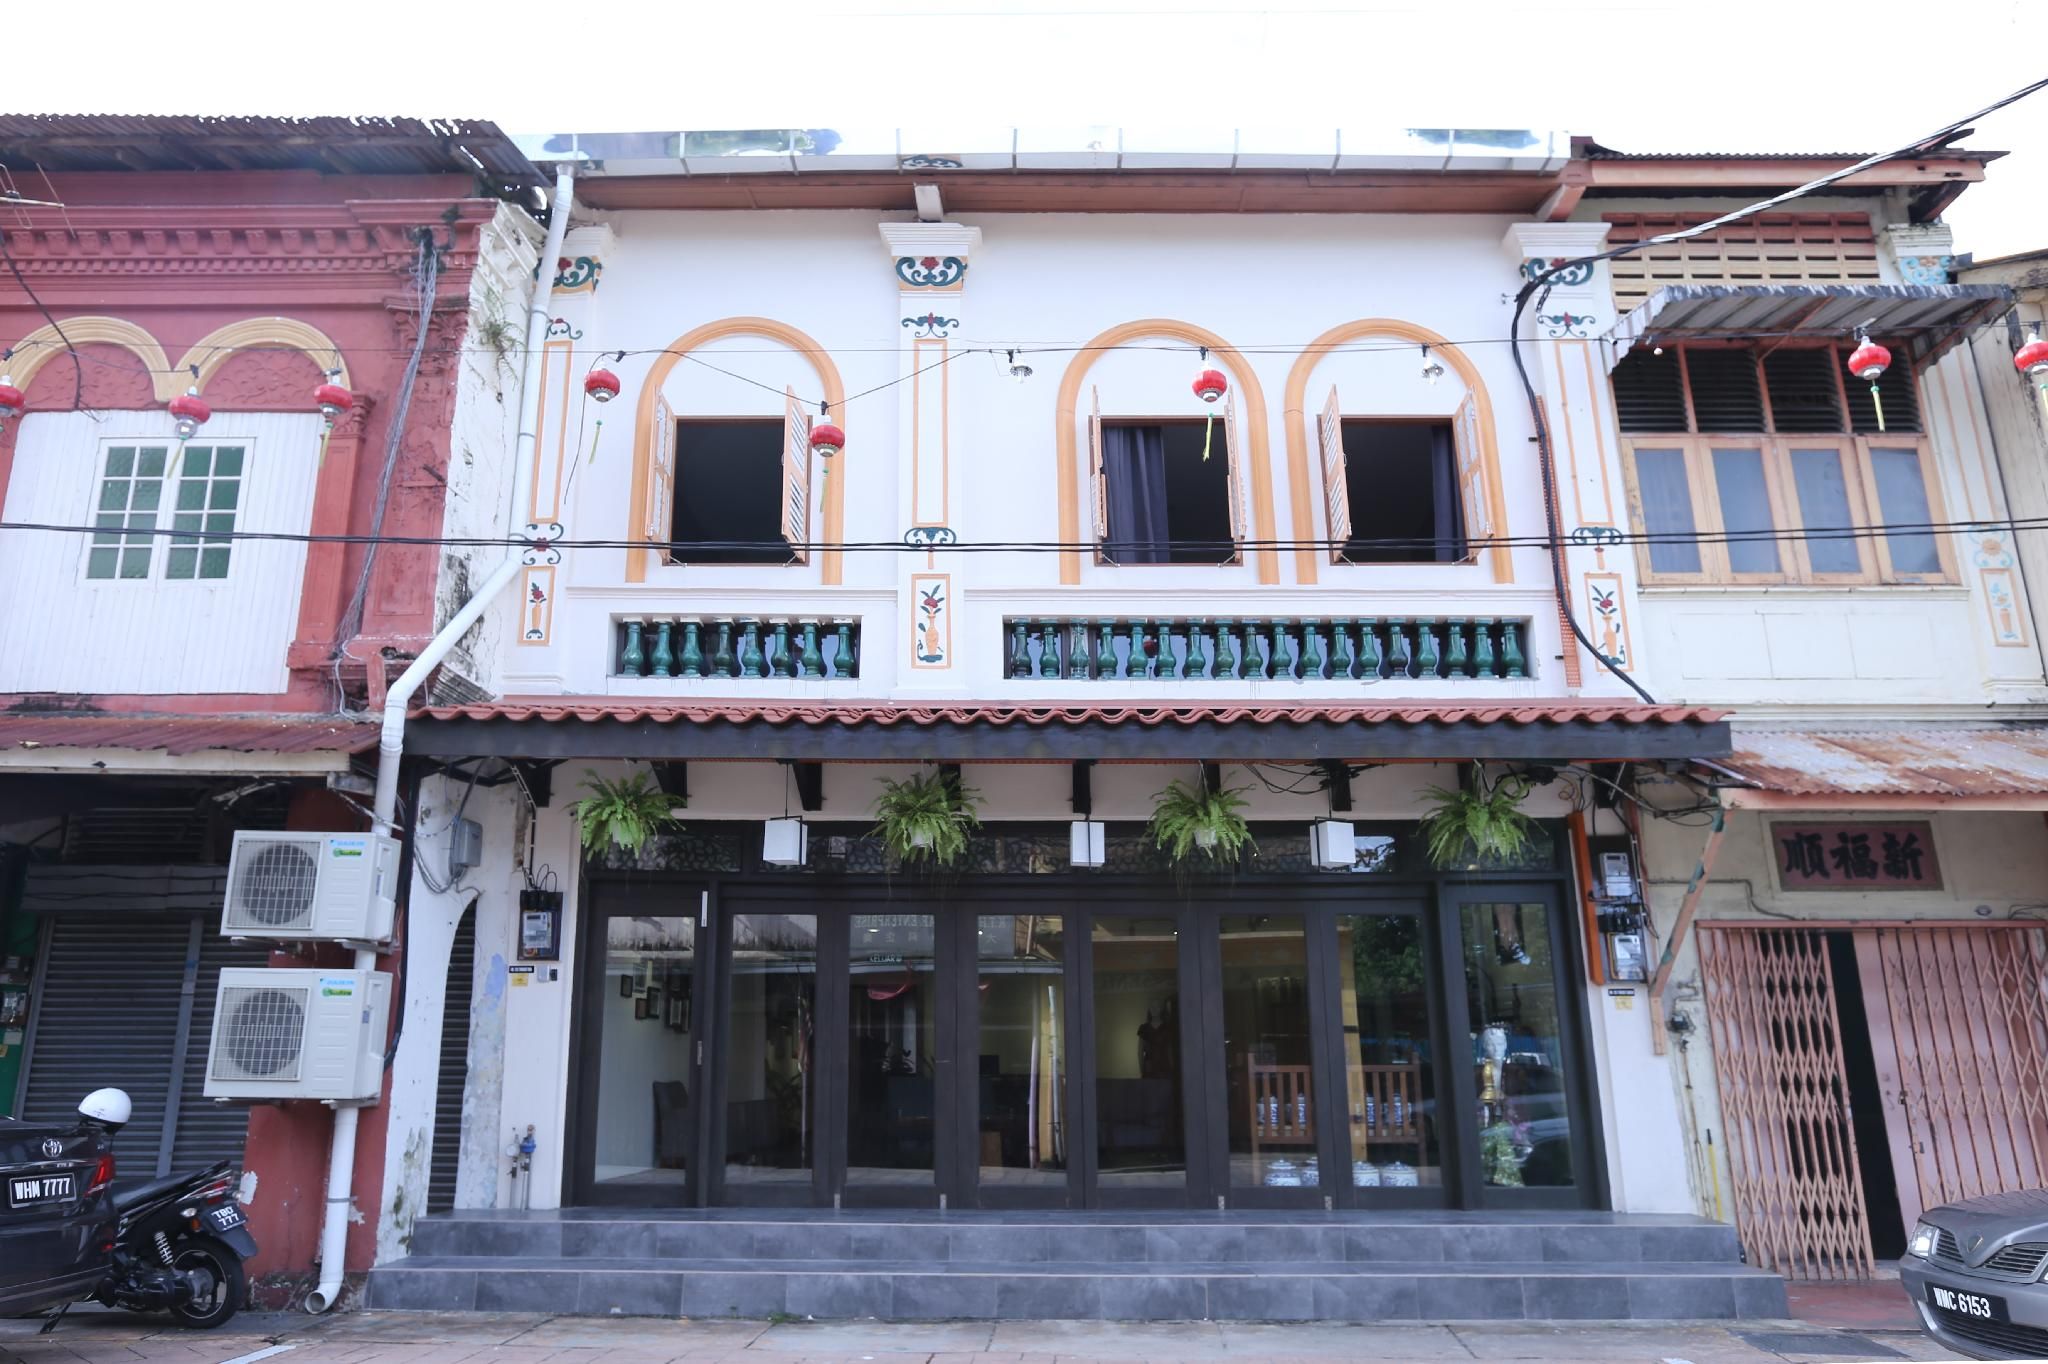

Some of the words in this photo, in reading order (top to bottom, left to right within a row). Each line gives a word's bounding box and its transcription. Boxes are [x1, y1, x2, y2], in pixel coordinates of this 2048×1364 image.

[14, 1181, 40, 1200] WHM
[42, 1178, 71, 1197] 7777
[218, 1213, 239, 1226] 777
[1933, 1287, 1957, 1310] WMC
[1958, 1293, 1991, 1318] 6153
